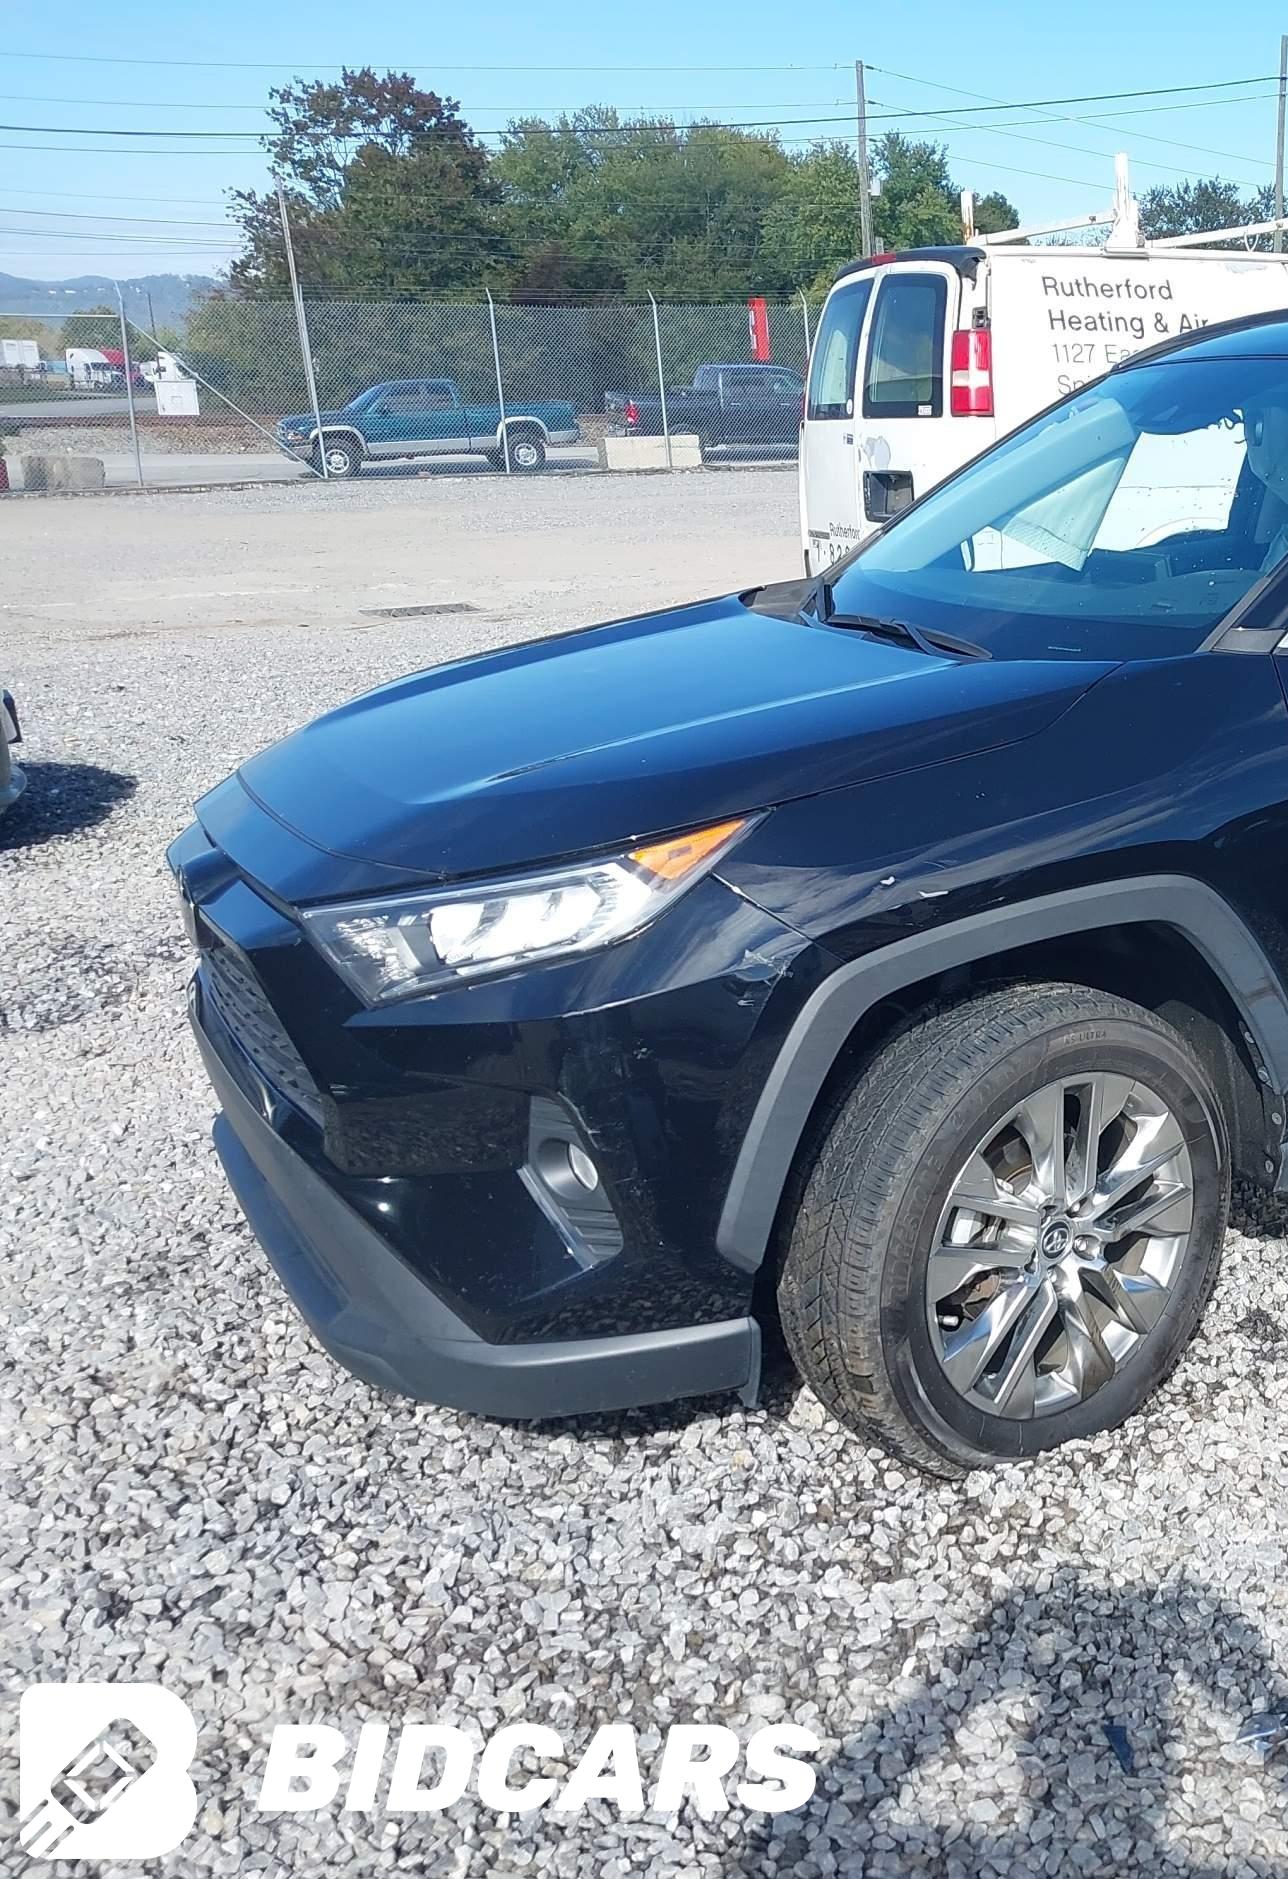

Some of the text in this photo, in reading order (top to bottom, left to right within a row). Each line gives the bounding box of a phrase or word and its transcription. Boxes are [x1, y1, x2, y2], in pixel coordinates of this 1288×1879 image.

[1041, 275, 1173, 301] Rutherford
[1048, 309, 1146, 340] Heating
[1154, 312, 1170, 334] &
[1052, 343, 1095, 364] 1127
